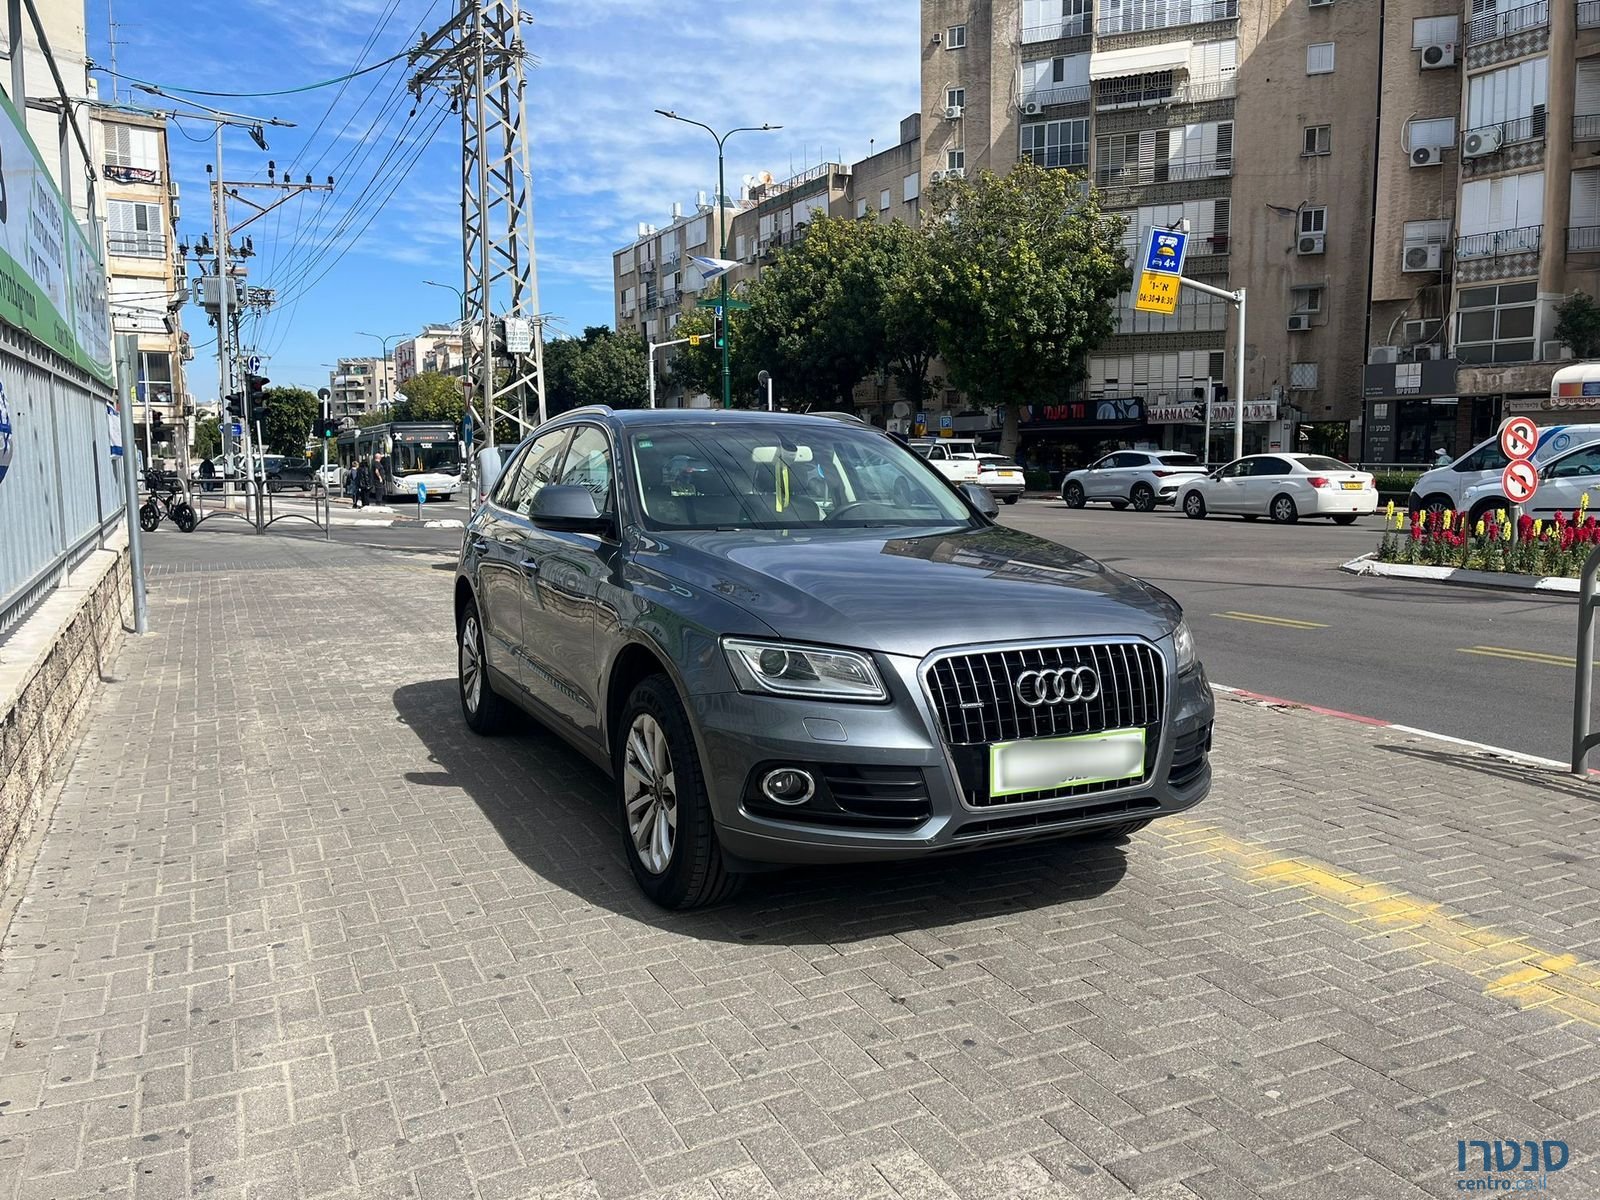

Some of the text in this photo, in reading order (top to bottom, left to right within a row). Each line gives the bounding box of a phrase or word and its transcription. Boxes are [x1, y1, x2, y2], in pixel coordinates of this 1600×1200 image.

[1164, 258, 1175, 267] 4+
[1043, 404, 1085, 420] חד פעמי
